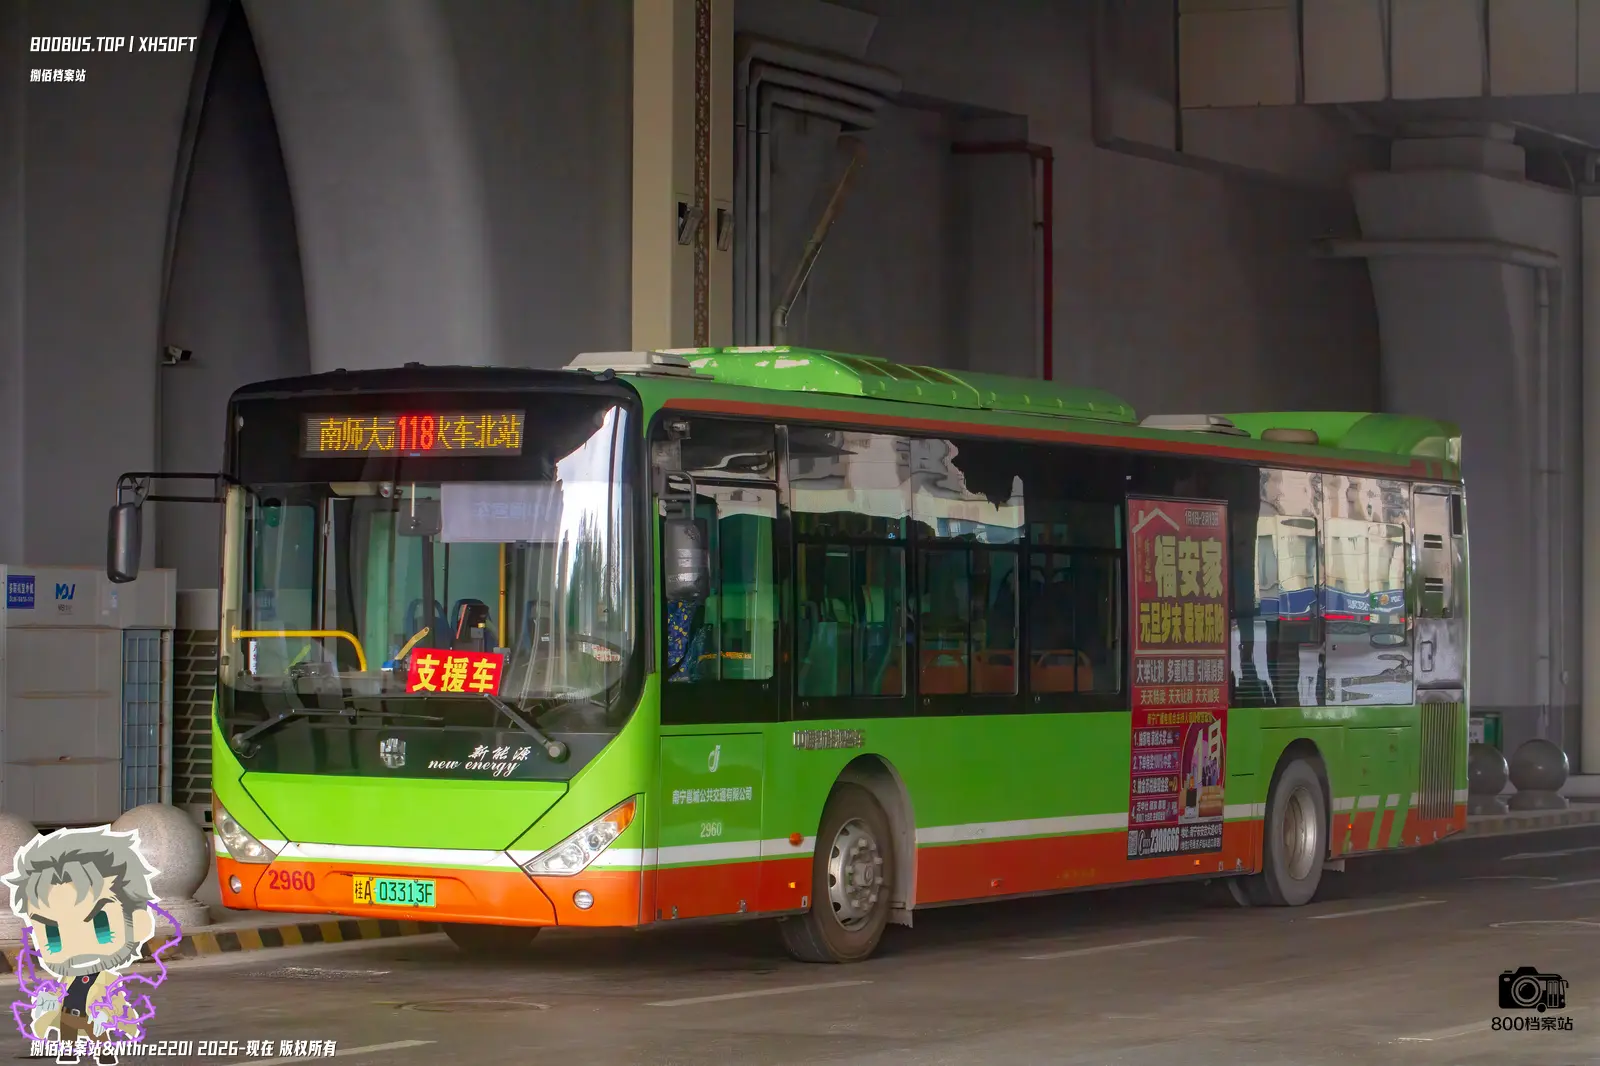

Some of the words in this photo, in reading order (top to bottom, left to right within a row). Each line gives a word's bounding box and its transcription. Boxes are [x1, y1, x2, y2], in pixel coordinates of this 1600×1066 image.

[398, 415, 435, 451] 118
[1139, 602, 1183, 644] 元旦岁末
[412, 653, 497, 693] 支援车
[1136, 659, 1165, 684] 大举让利
[1166, 659, 1195, 684] 多重优惠
[467, 744, 532, 762] 新能源
[427, 759, 462, 770] new
[464, 758, 521, 778] energy
[700, 821, 722, 838] 2960
[267, 868, 316, 892] 2960
[354, 880, 373, 901] 桂A
[379, 881, 434, 904] 03313F
